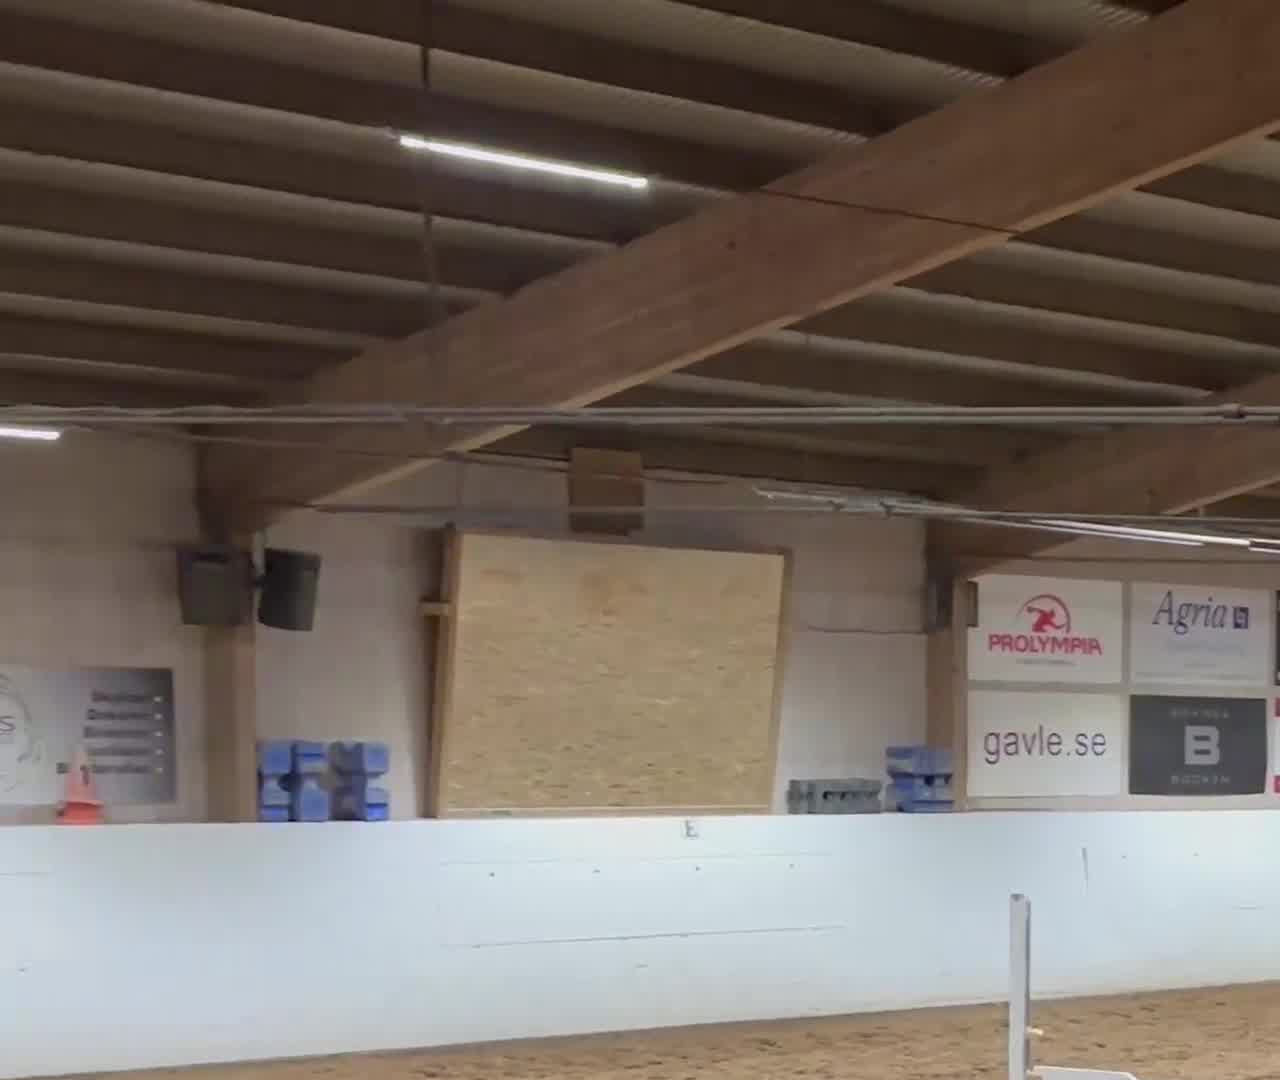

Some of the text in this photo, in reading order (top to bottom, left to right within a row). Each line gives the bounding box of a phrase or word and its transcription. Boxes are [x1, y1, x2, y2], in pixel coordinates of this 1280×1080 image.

[1151, 591, 1228, 636] Agria
[987, 634, 1103, 656] PROLYMPIA
[983, 723, 1107, 765] gavle.se
[1184, 725, 1220, 766] B
